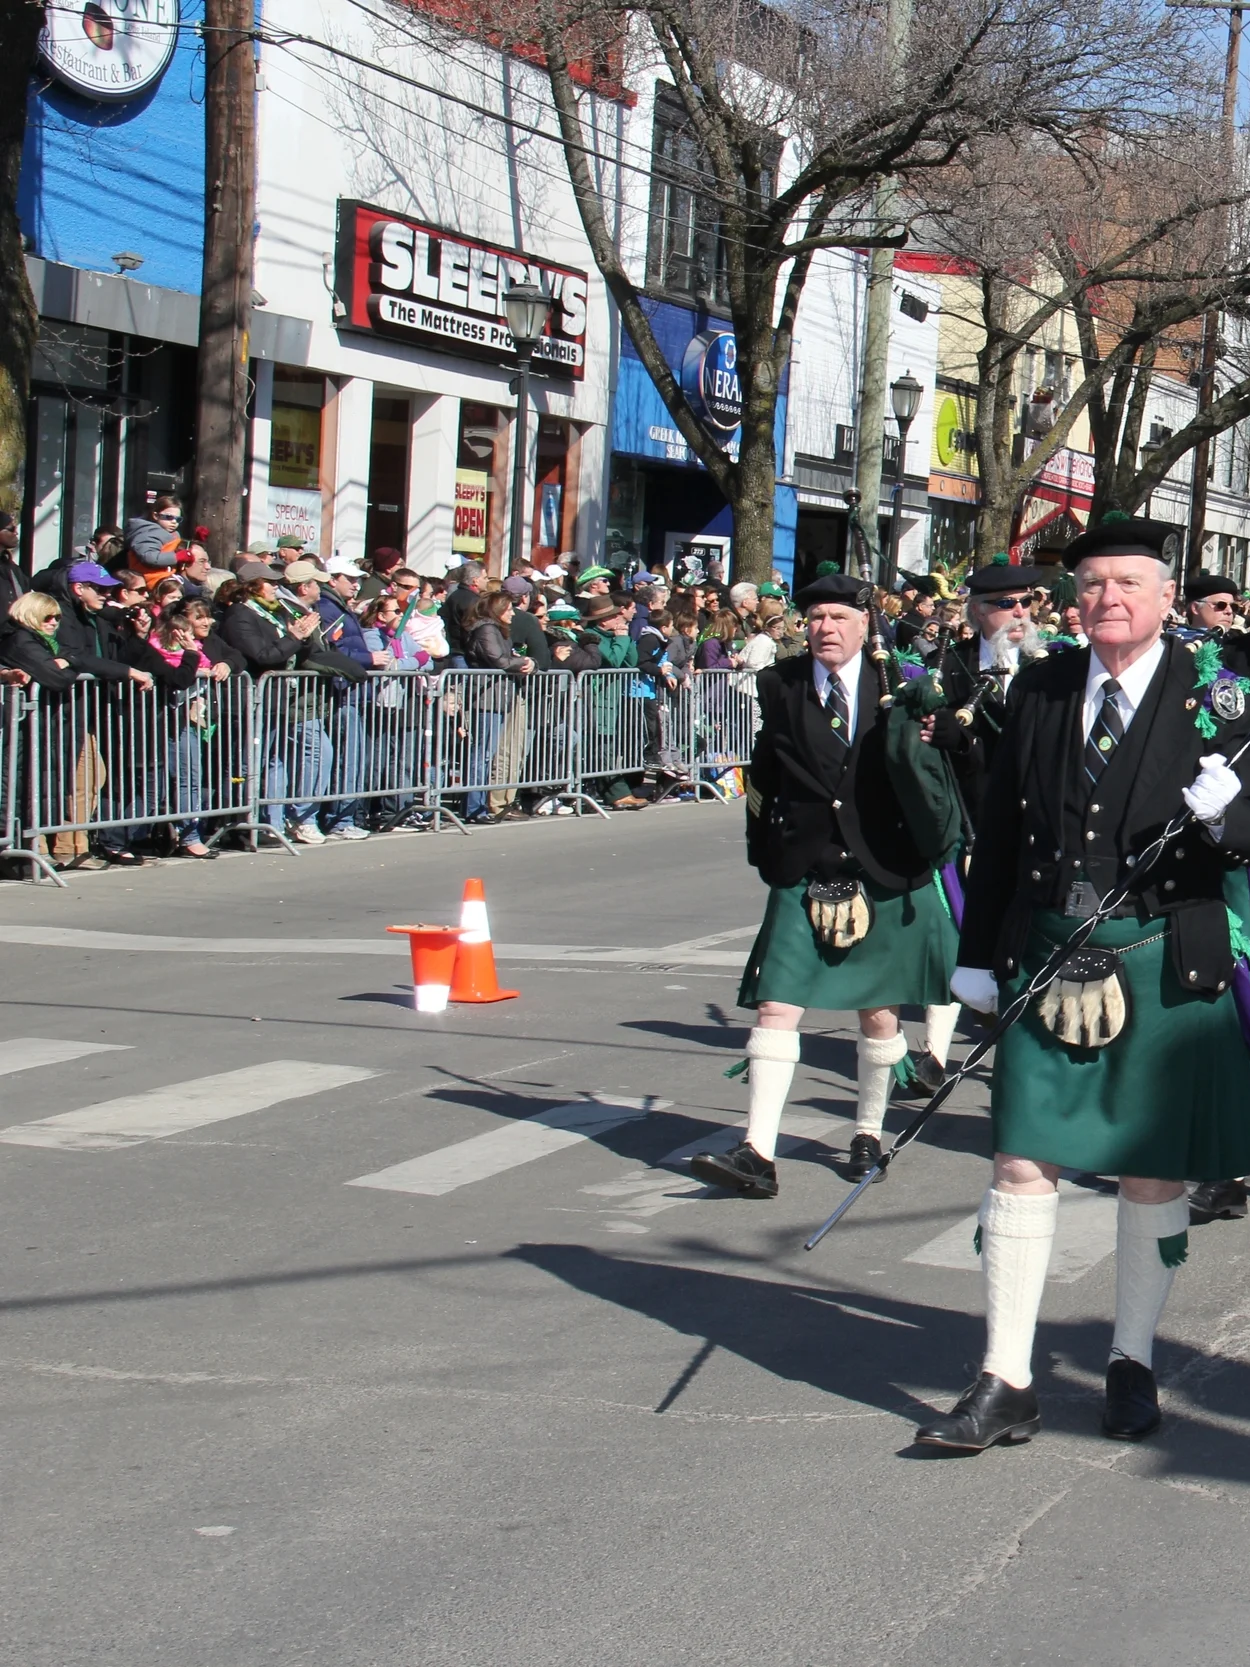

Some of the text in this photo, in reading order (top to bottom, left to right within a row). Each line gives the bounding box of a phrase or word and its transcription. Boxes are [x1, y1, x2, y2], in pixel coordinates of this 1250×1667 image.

[111, 63, 120, 83] &
[122, 62, 142, 83] Bar
[389, 300, 416, 324] The
[421, 308, 485, 340] Mattress
[276, 504, 309, 521] SPECIAL
[454, 506, 484, 537] OPEN
[267, 522, 315, 541] FINANCING
